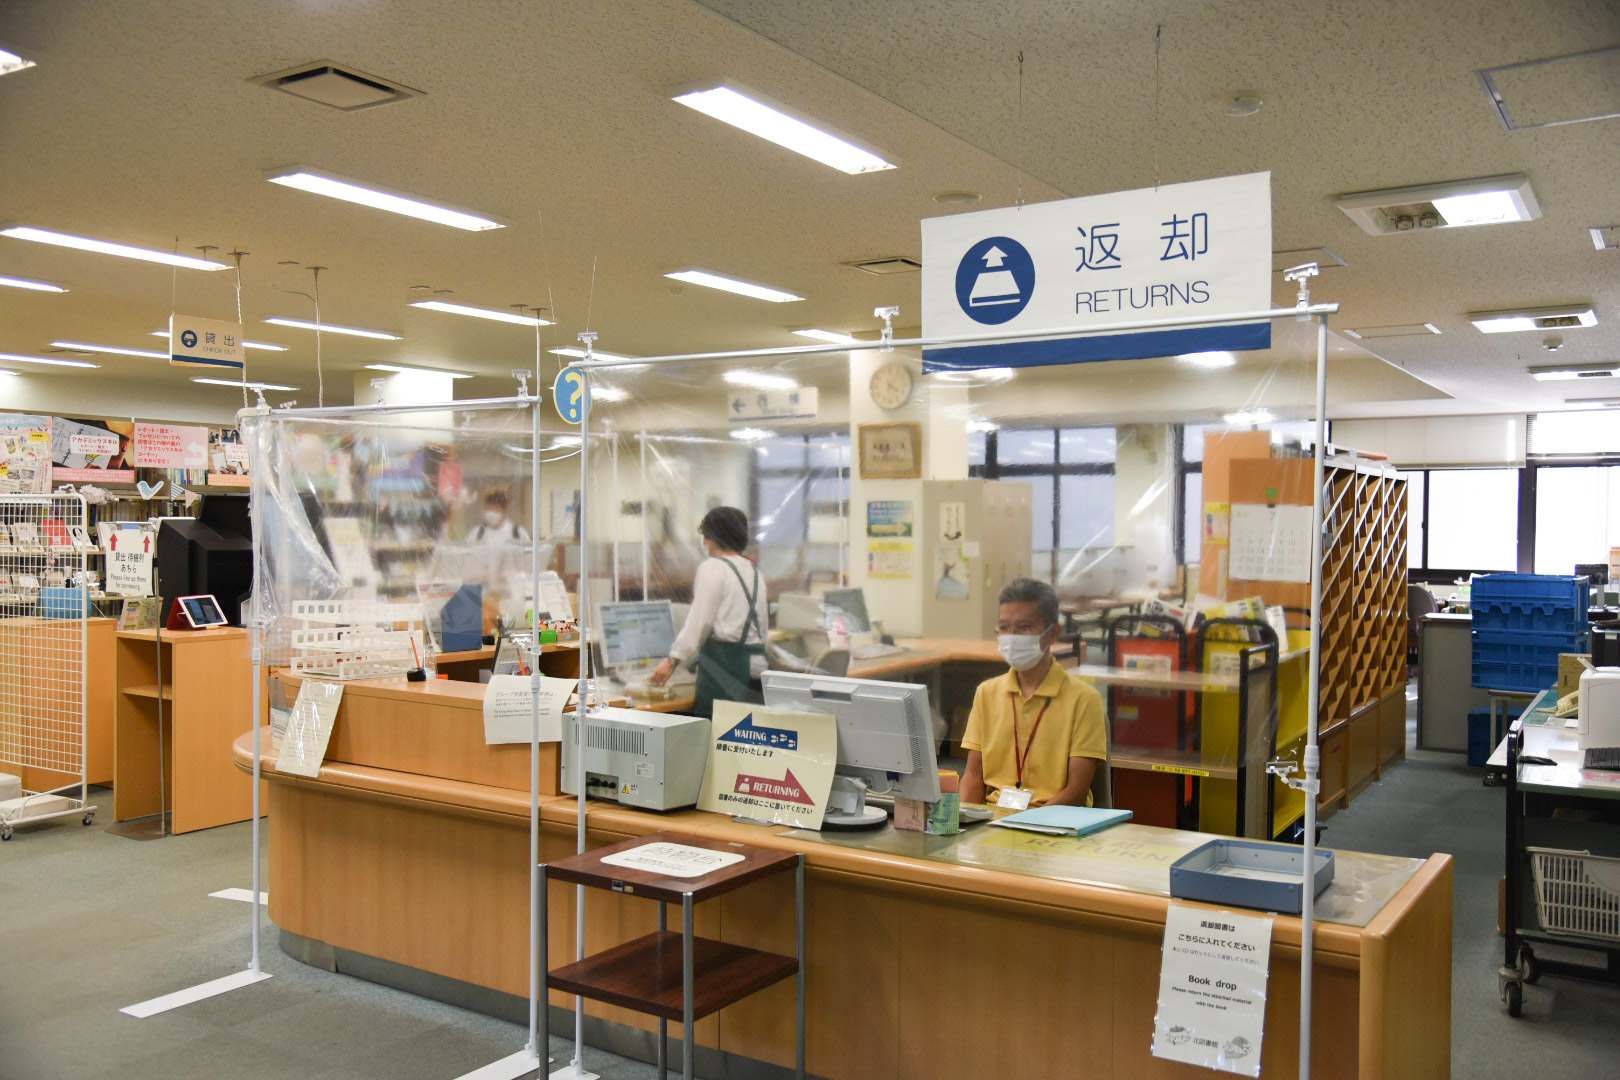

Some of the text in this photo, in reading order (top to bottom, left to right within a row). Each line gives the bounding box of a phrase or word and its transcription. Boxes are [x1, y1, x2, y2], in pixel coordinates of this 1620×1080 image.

[1075, 212, 1209, 273] 返却
[1075, 280, 1211, 314] RETURNS
[205, 331, 235, 347] 貸出
[115, 552, 126, 562] 貸出
[120, 563, 137, 574] あちら
[110, 573, 122, 581] Please
[734, 728, 767, 741] WAITING
[715, 743, 774, 758] 順番に受付いたします
[753, 781, 800, 798] RETURNING
[718, 793, 813, 815] 図書のみの返却はここに置いてください
[1200, 920, 1235, 932] 返却図書は
[1178, 933, 1256, 952] こちらに入れてください
[1188, 974, 1237, 992] Book drop
[1211, 993, 1232, 1001] attached
[1232, 997, 1252, 1005] material
